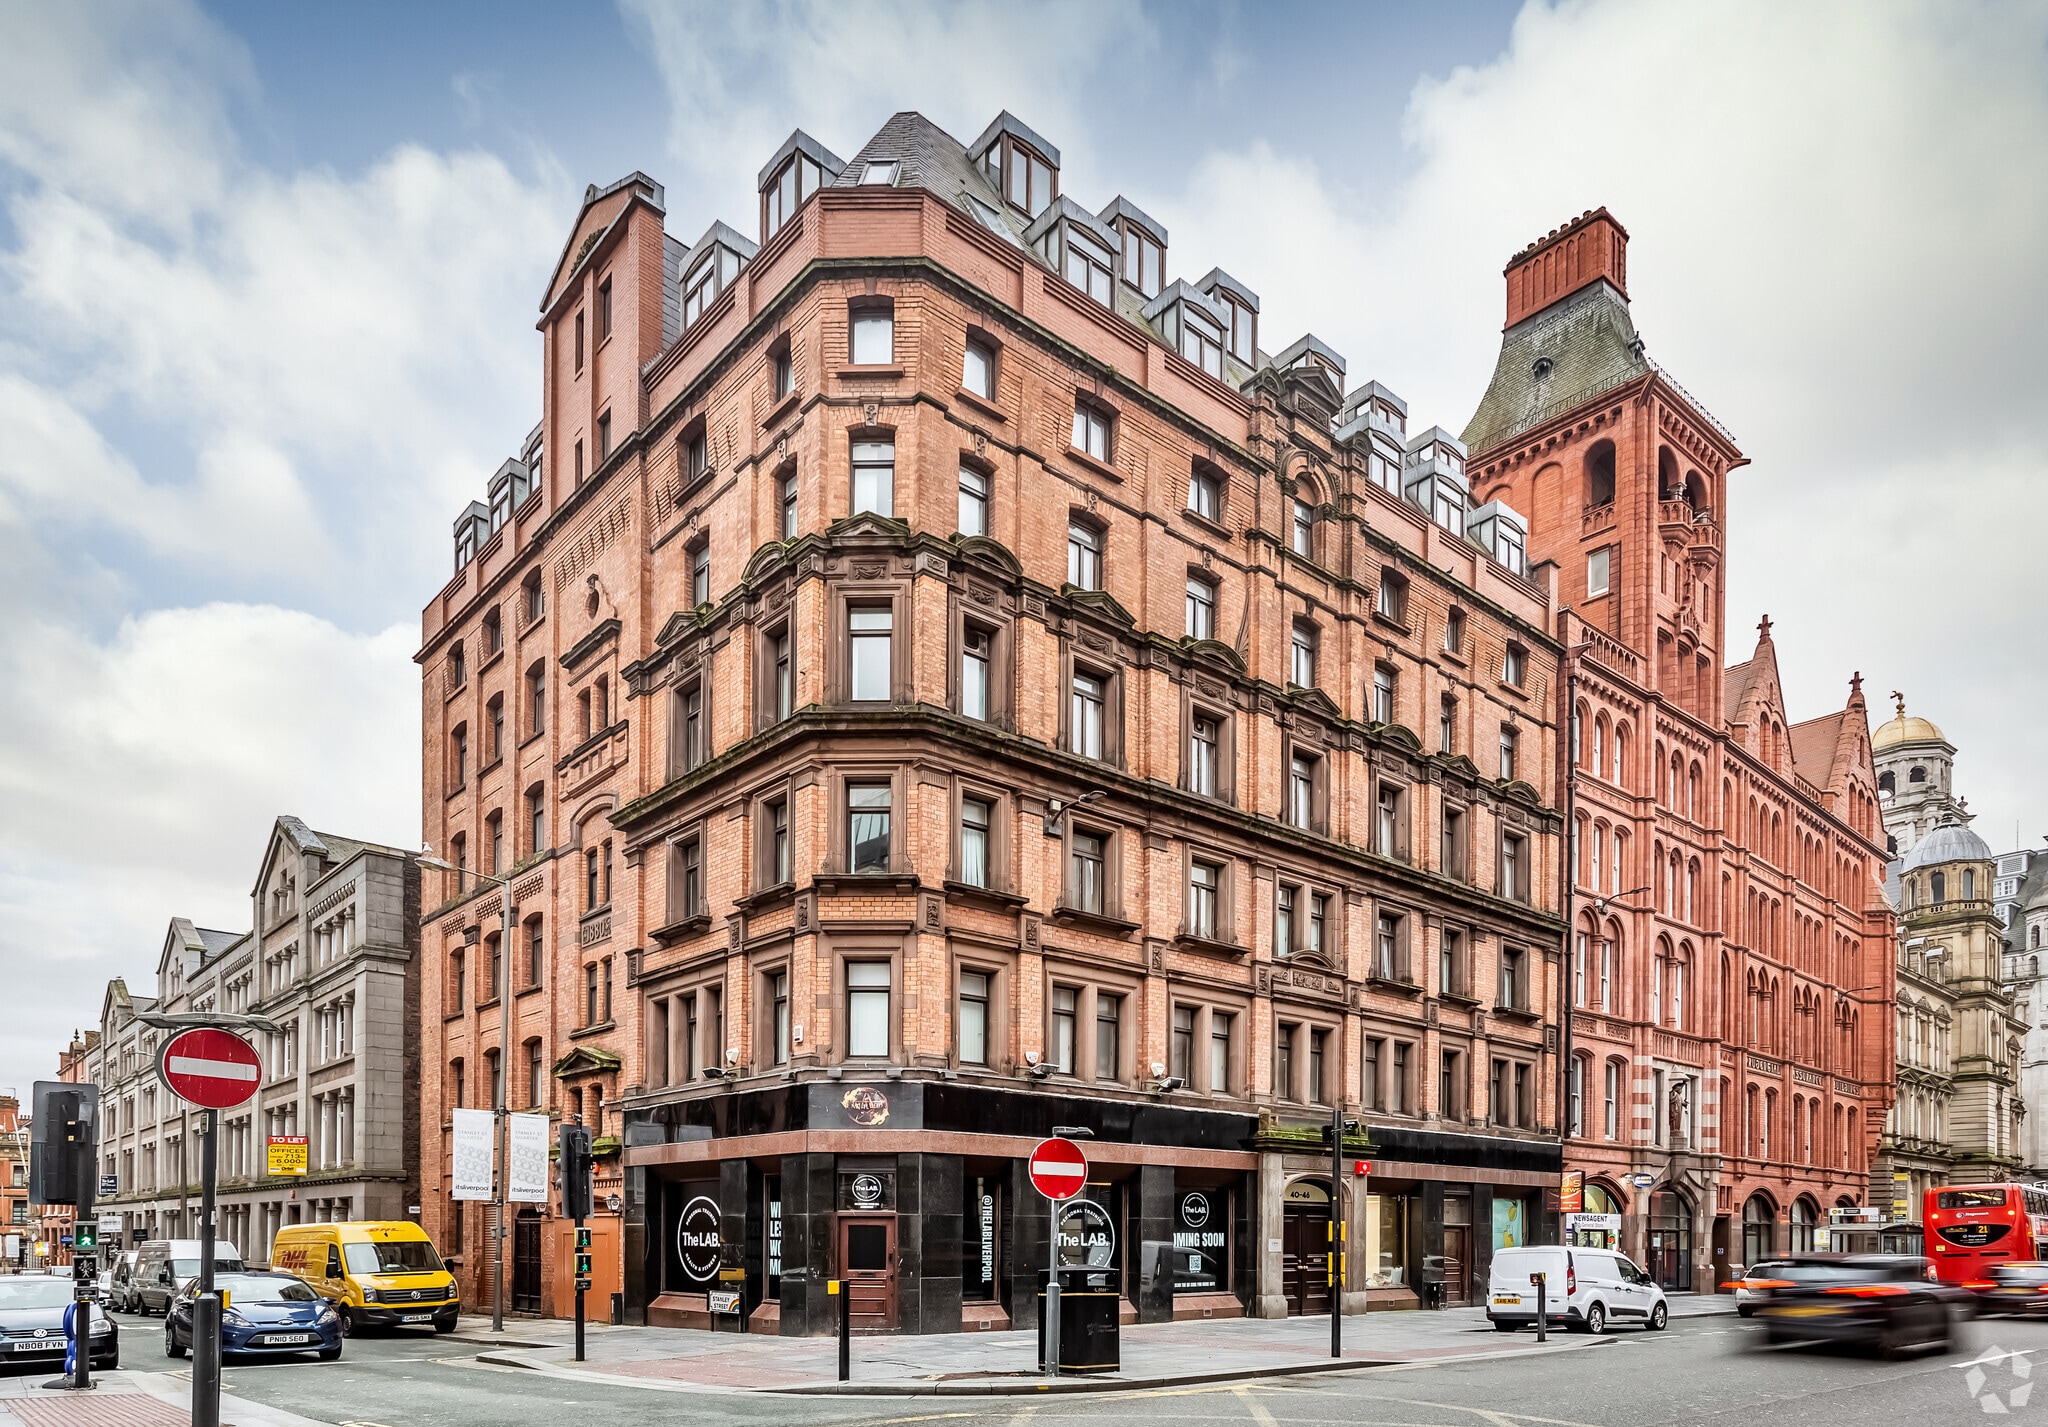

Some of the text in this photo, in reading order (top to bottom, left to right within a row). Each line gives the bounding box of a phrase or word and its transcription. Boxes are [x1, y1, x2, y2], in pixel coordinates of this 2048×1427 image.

[686, 1208, 717, 1226] PERSONAL TRAINING
[1060, 1209, 1105, 1226] PERSONAL TRAINING
[1574, 1214, 1608, 1222] NEWSAGENT
[1978, 1225, 1989, 1233] 21
[682, 1232, 698, 1247] The
[982, 1195, 993, 1283] @THELABLIVERPOOL
[1057, 1233, 1080, 1246] The
[1202, 1232, 1224, 1247] SOON
[280, 1250, 308, 1269] DHL
[45, 1341, 64, 1349] FVN
